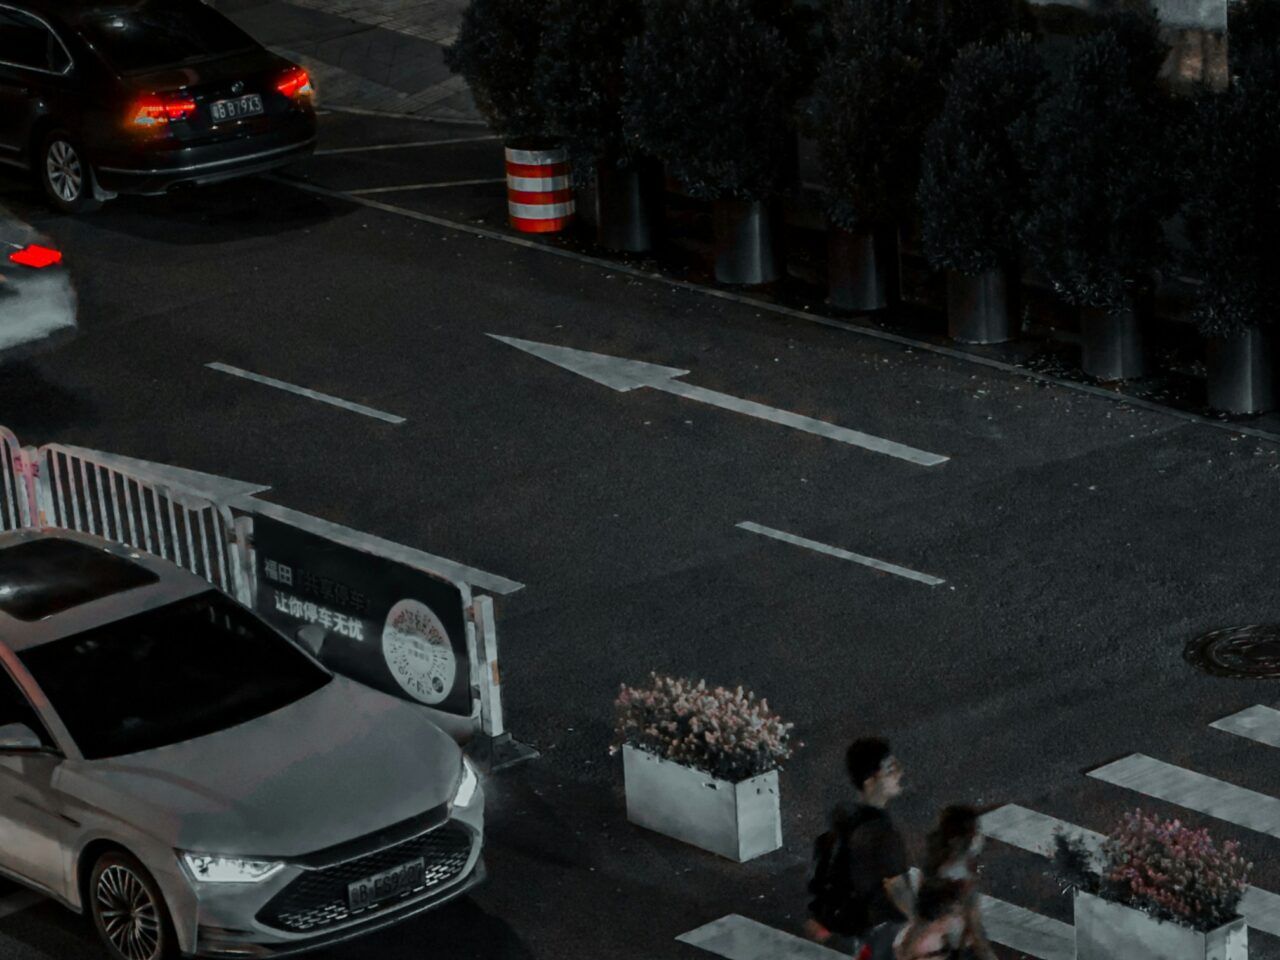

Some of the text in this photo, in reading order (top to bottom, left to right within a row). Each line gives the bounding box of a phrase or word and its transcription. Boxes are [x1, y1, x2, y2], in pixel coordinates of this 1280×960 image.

[264, 557, 293, 586] 福田
[274, 590, 364, 641] 让你停车无忧
